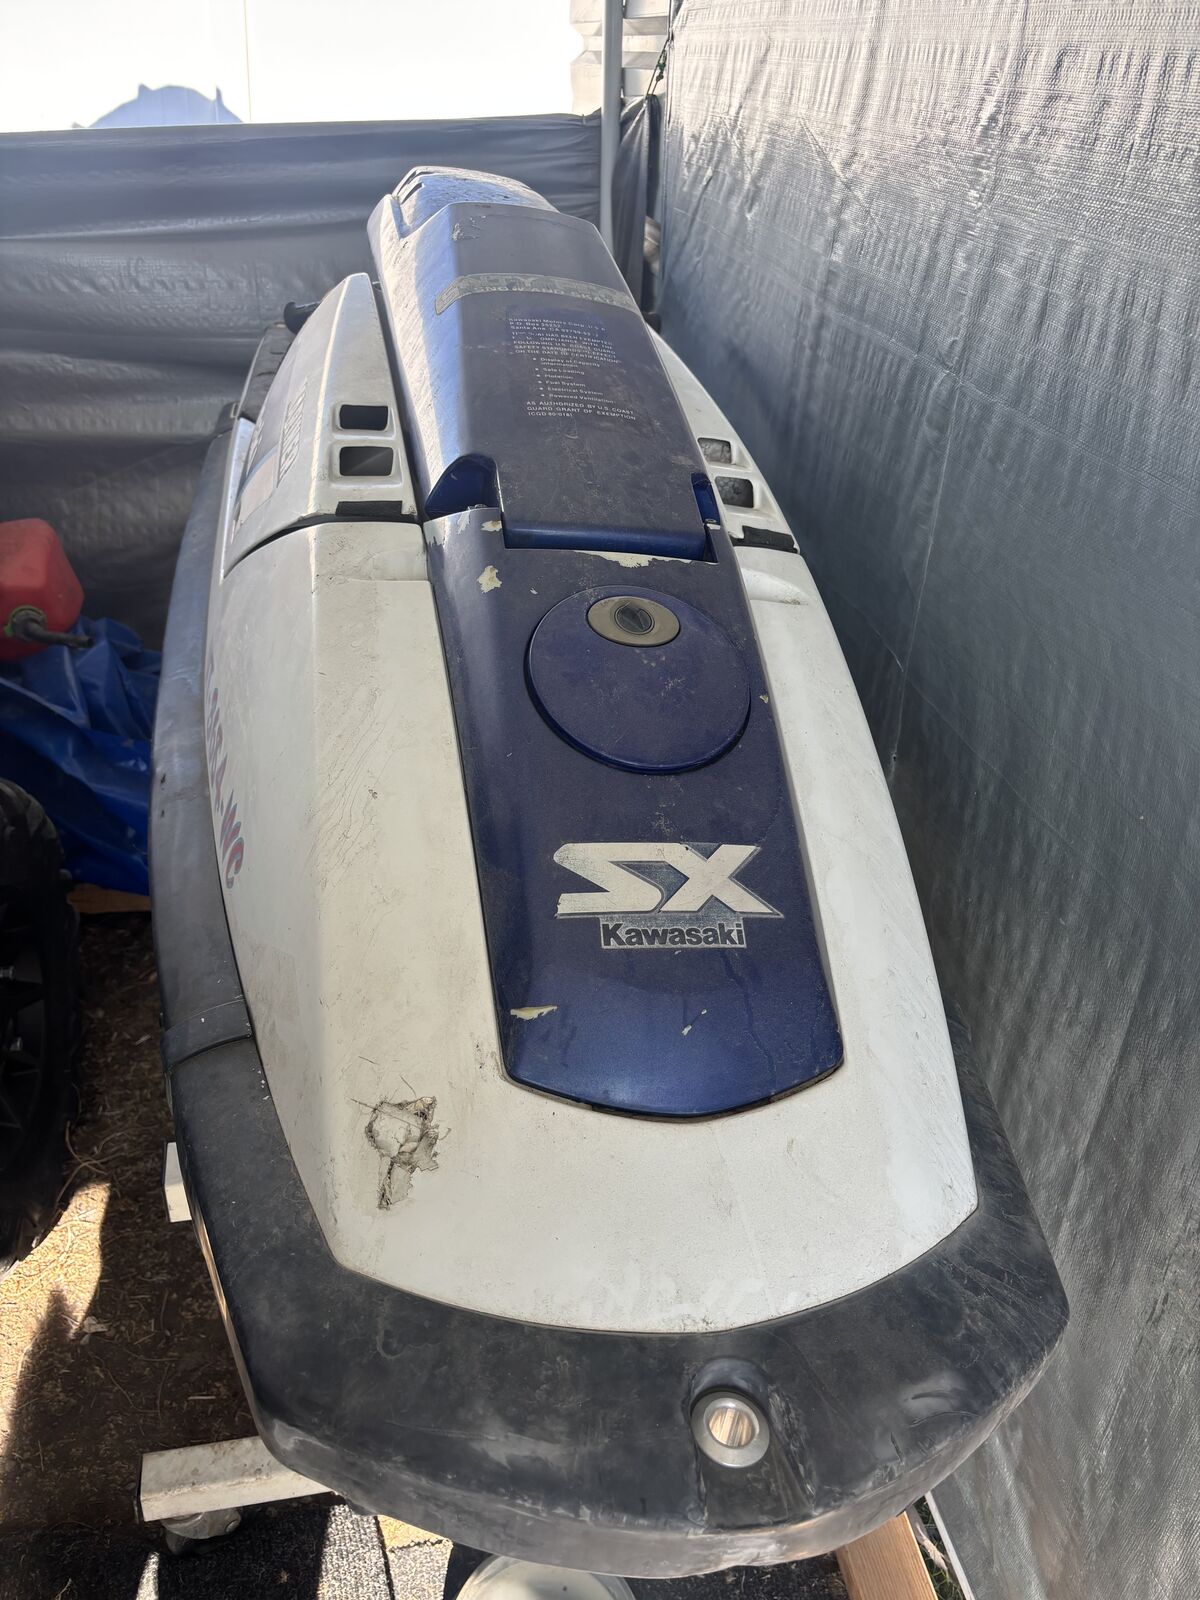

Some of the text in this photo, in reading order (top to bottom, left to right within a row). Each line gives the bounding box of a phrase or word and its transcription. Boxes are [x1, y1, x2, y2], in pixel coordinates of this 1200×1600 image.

[539, 401, 585, 409] AUTHORIZED
[612, 407, 634, 415] COAST
[596, 410, 636, 420] EXEMPTION
[552, 841, 784, 918] SX
[601, 922, 745, 947] Kawasaki
